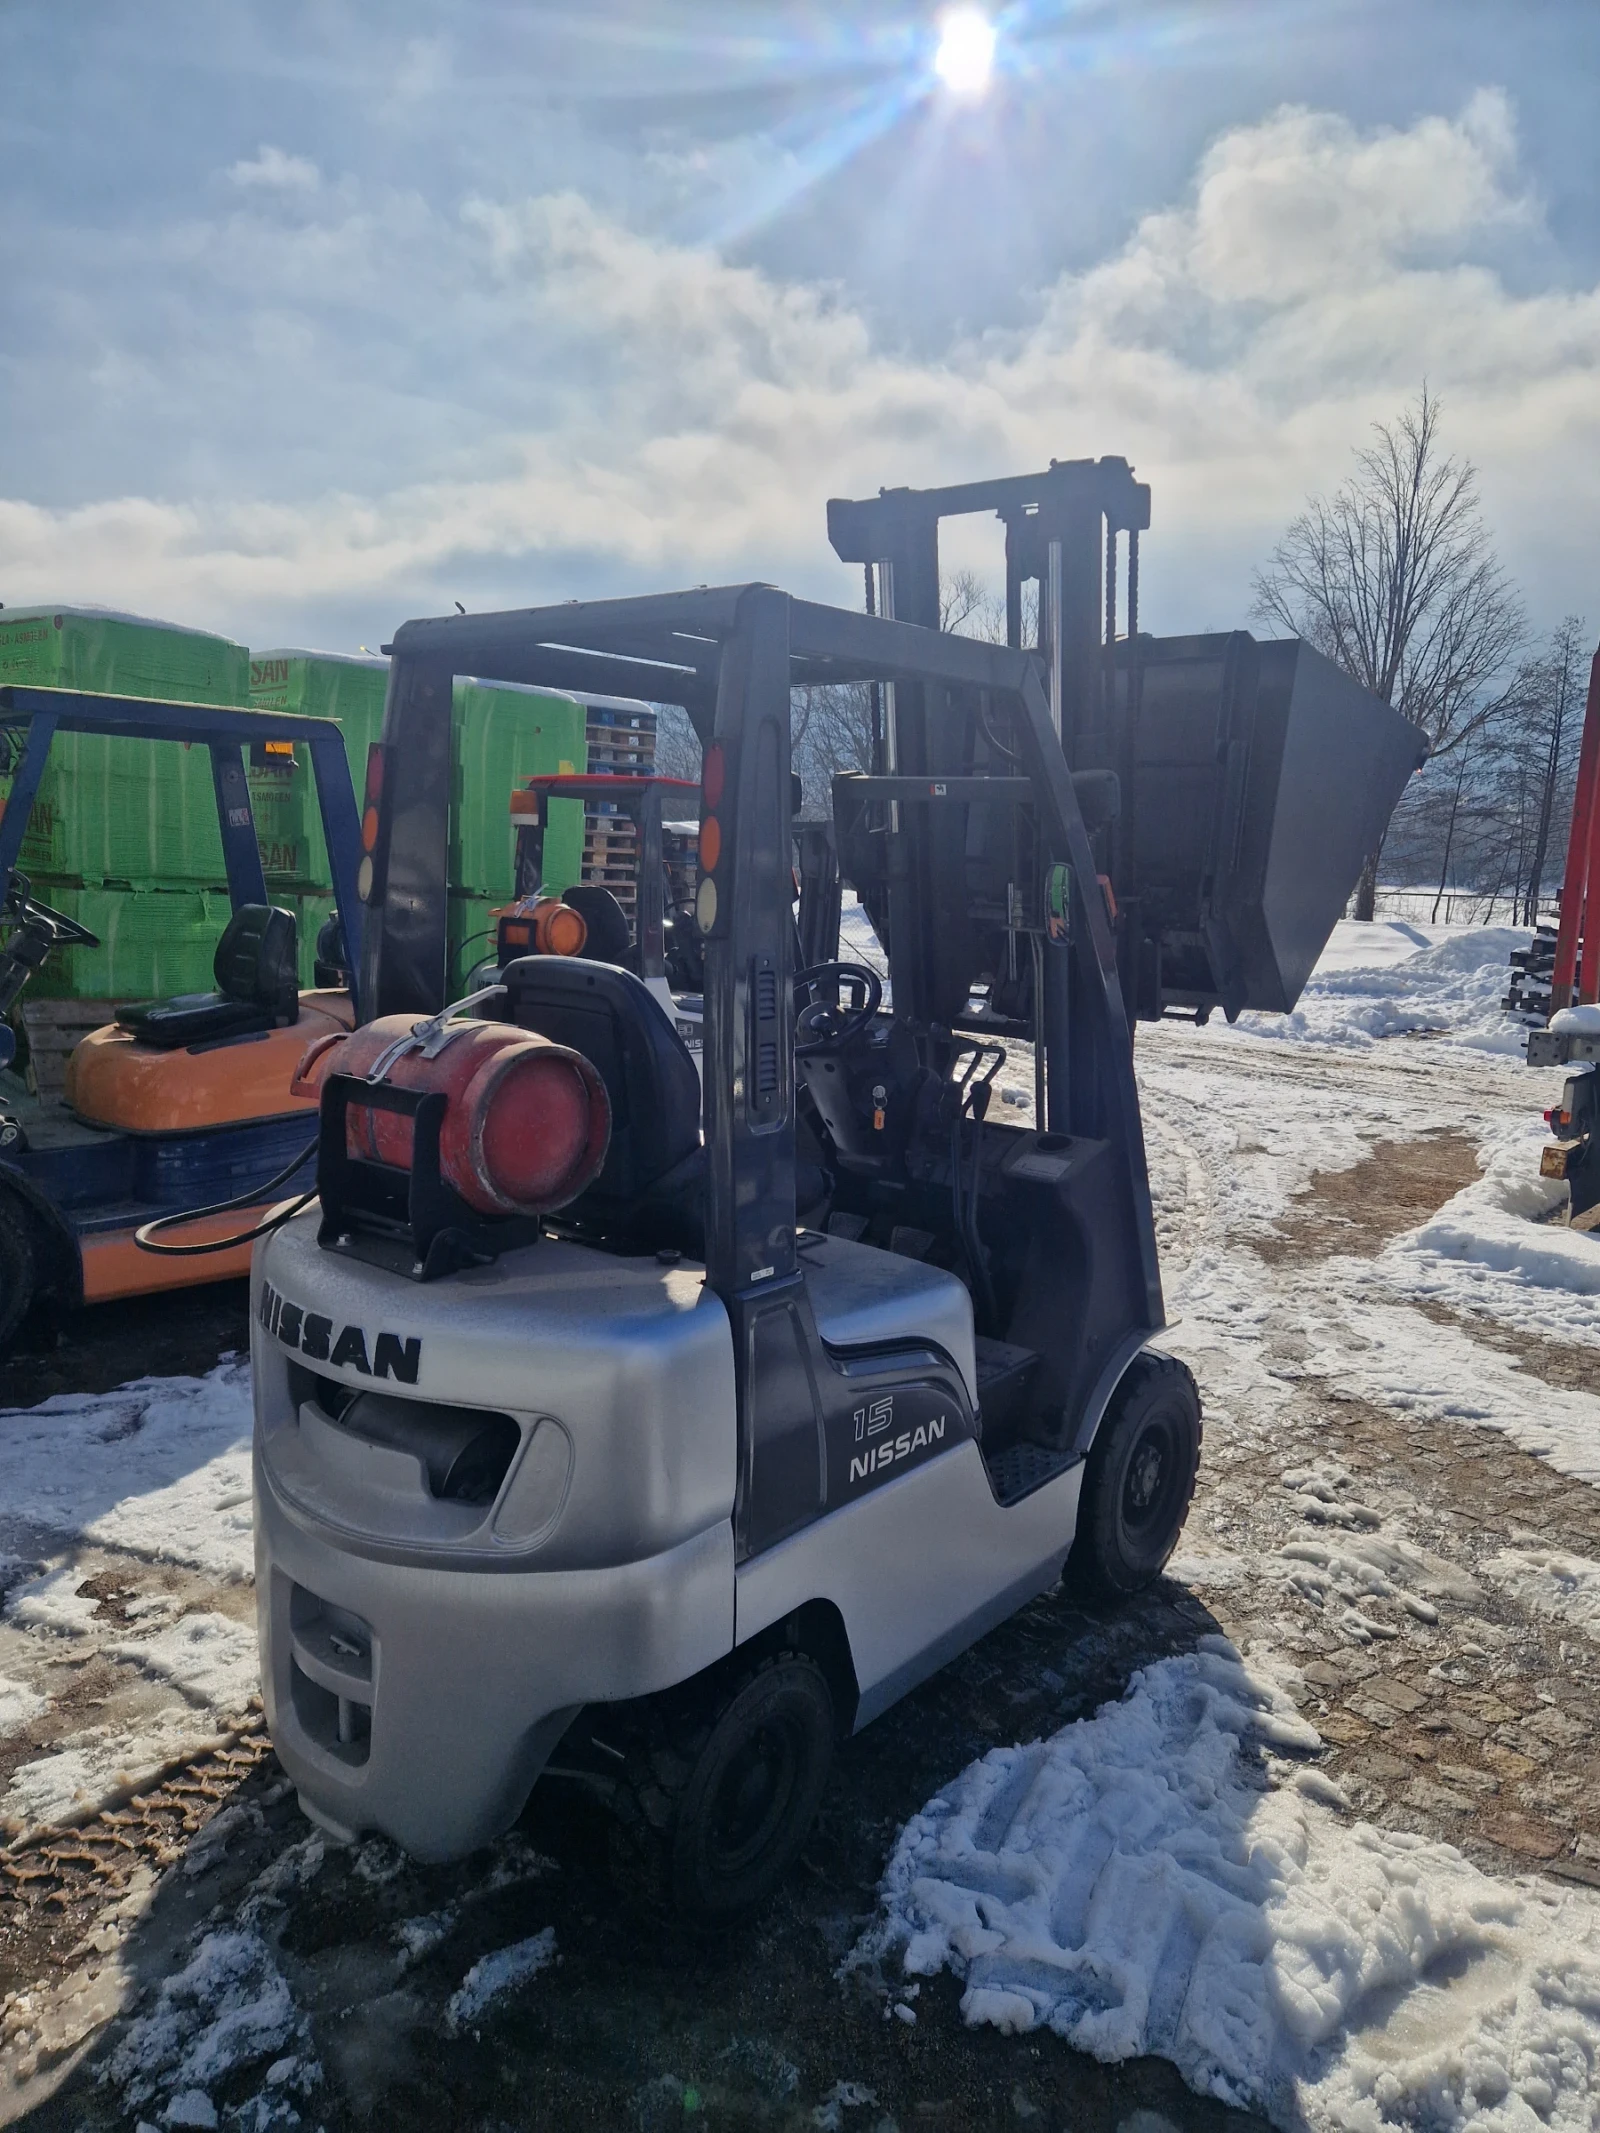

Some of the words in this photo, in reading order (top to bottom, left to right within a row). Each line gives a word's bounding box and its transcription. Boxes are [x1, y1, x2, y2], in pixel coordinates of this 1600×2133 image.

[260, 1279, 422, 1385] NISSAN
[849, 1415, 946, 1483] NISSAN
[853, 1395, 894, 1442] 15
